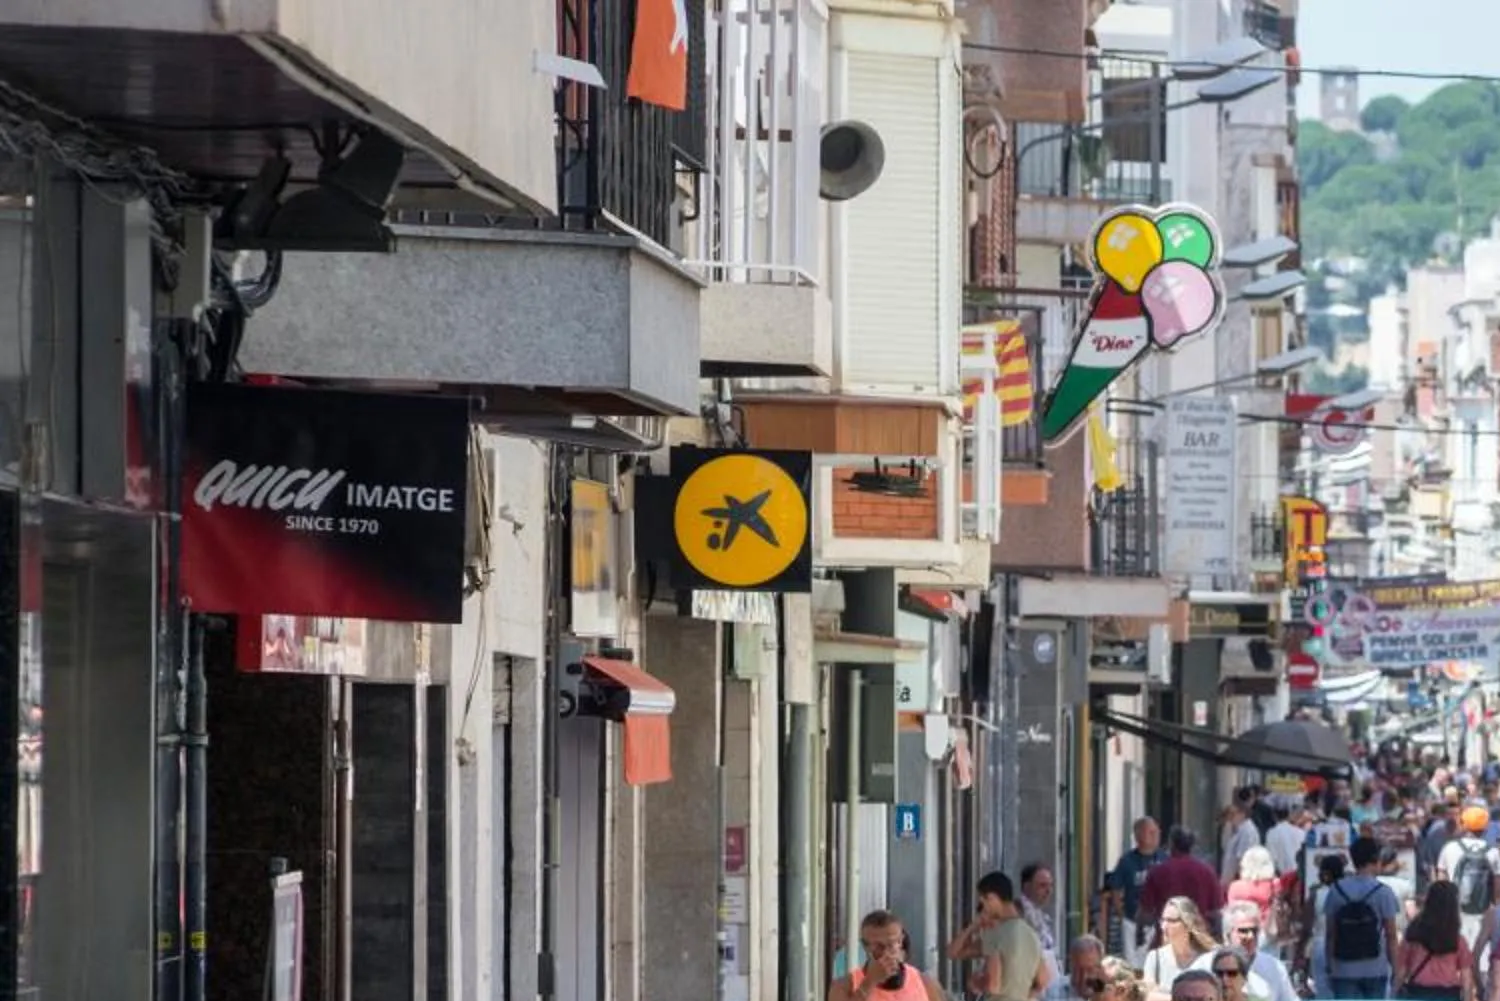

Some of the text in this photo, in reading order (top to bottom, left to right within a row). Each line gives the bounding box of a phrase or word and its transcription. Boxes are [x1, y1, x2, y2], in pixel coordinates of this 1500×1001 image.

[1183, 431, 1221, 447] BAR
[347, 483, 454, 512] IMATGE
[285, 515, 379, 534] SINCE 1970
